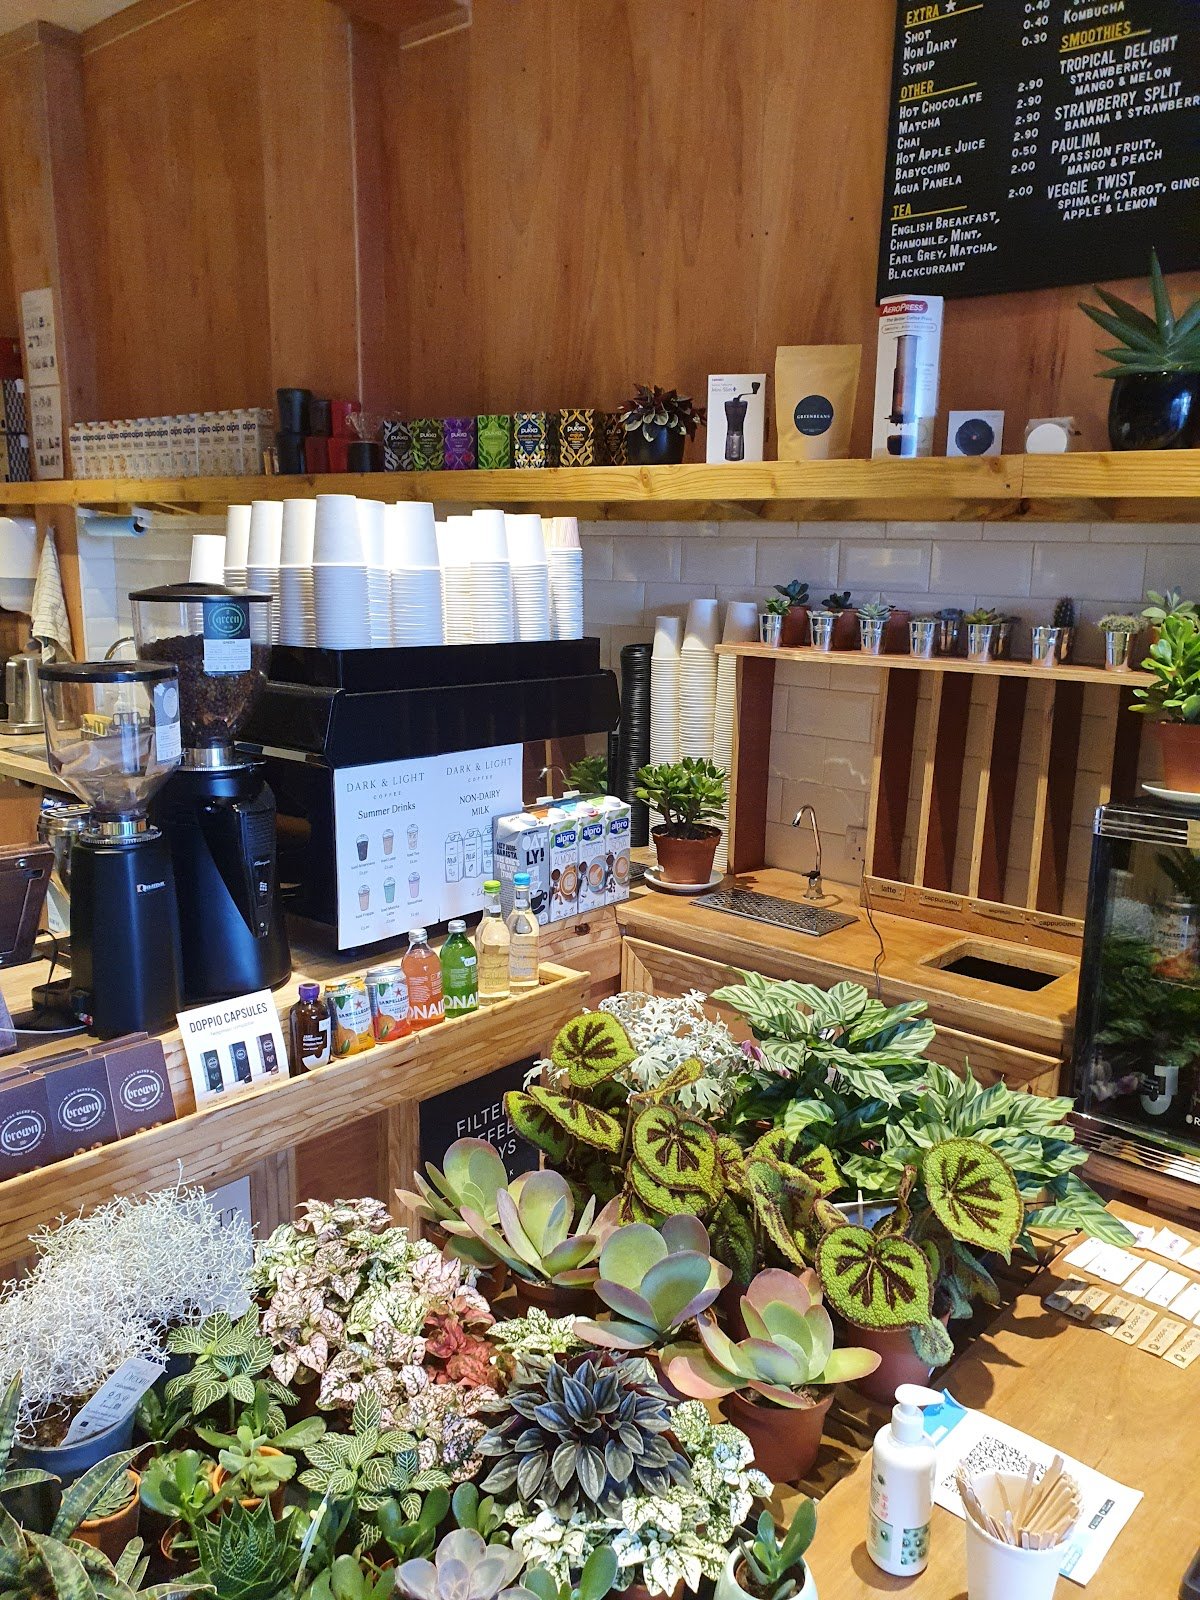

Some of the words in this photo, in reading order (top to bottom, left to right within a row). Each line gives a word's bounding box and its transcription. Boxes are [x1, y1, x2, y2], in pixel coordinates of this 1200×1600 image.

[906, 3, 940, 25] EXTRA
[1063, 1, 1125, 24] KOMBUCHA
[1022, 15, 1049, 30] 0.40
[904, 29, 932, 45] SHOT
[1021, 32, 1048, 46] 0.30
[1061, 21, 1131, 49] SMOOTHIES
[903, 46, 924, 60] NON
[926, 38, 957, 55] DAIRY
[1060, 50, 1117, 74] TROPICAL
[1124, 35, 1178, 60] DELIGHT
[902, 60, 935, 76] SYRUP
[1070, 59, 1152, 85] STRAWBERRY,
[901, 80, 934, 99] OTHER
[1017, 78, 1044, 92] 2.90
[1075, 79, 1114, 96] MANGO
[1118, 76, 1126, 87] &
[1130, 66, 1172, 84] MELON
[899, 106, 919, 119] HOT
[921, 92, 983, 114] CHOCOLATE
[1016, 94, 1042, 109] 2.90
[1054, 91, 1137, 121] STRAWBERRY
[1144, 82, 1182, 102] SPLIT
[898, 117, 941, 135] MATCHA
[1015, 111, 1041, 125] 2.90
[1064, 113, 1110, 131] BANANA
[1115, 110, 1122, 120] &
[897, 137, 920, 149] CHAI
[1013, 128, 1039, 142] 2.90
[1051, 132, 1101, 154] PAULINA
[896, 152, 915, 165] HOT
[918, 145, 952, 161] APPLE
[954, 139, 986, 153] JUICE
[1012, 144, 1037, 158] 0.50
[1061, 146, 1112, 164] PASSION
[1115, 139, 1156, 154] FRUIT,
[895, 162, 951, 180] BABYCCINO
[1010, 160, 1036, 174] 2.00
[1067, 160, 1106, 175] MANGO
[1110, 158, 1117, 168] &
[1121, 149, 1162, 166] PEACH
[893, 183, 919, 195] AGUA
[922, 175, 962, 190] PANELA
[1008, 185, 1034, 199] 2.00
[1047, 179, 1089, 199] VEGGIE
[1097, 171, 1136, 190] TWIST
[1058, 193, 1110, 210] SPINACH,
[1114, 183, 1166, 200] CARROT,
[893, 203, 912, 218] TEA
[1063, 206, 1101, 220] APPLE
[1105, 204, 1112, 214] &
[1116, 197, 1158, 212] LEMON
[891, 221, 933, 237] ENGLISH
[935, 211, 1000, 230] BREAKFAST,
[890, 235, 948, 251] CHAMOMILE,
[889, 253, 914, 266] EARL
[917, 249, 947, 262] GREY,
[888, 262, 966, 280] BLACKCURRANT
[446, 764, 471, 776] DARK
[475, 762, 481, 771] &
[485, 757, 513, 769] LIGHT
[346, 780, 376, 793] DARK
[381, 778, 388, 787] &
[392, 772, 424, 786] LIGHT
[459, 789, 501, 804] NON-DAIRY
[357, 807, 390, 820] Summer
[391, 801, 416, 814] Drinks
[471, 805, 490, 817] MILK
[583, 826, 601, 837] alpro
[611, 820, 628, 831] alpro
[522, 832, 548, 850] OAT
[556, 833, 575, 844] alpro
[189, 1015, 223, 1033] DOPPIO
[223, 1002, 268, 1024] CAPSULES
[127, 1083, 159, 1100] brown
[66, 1102, 98, 1119] brown
[456, 1101, 507, 1138] FILTE
[4, 1124, 39, 1143] brown
